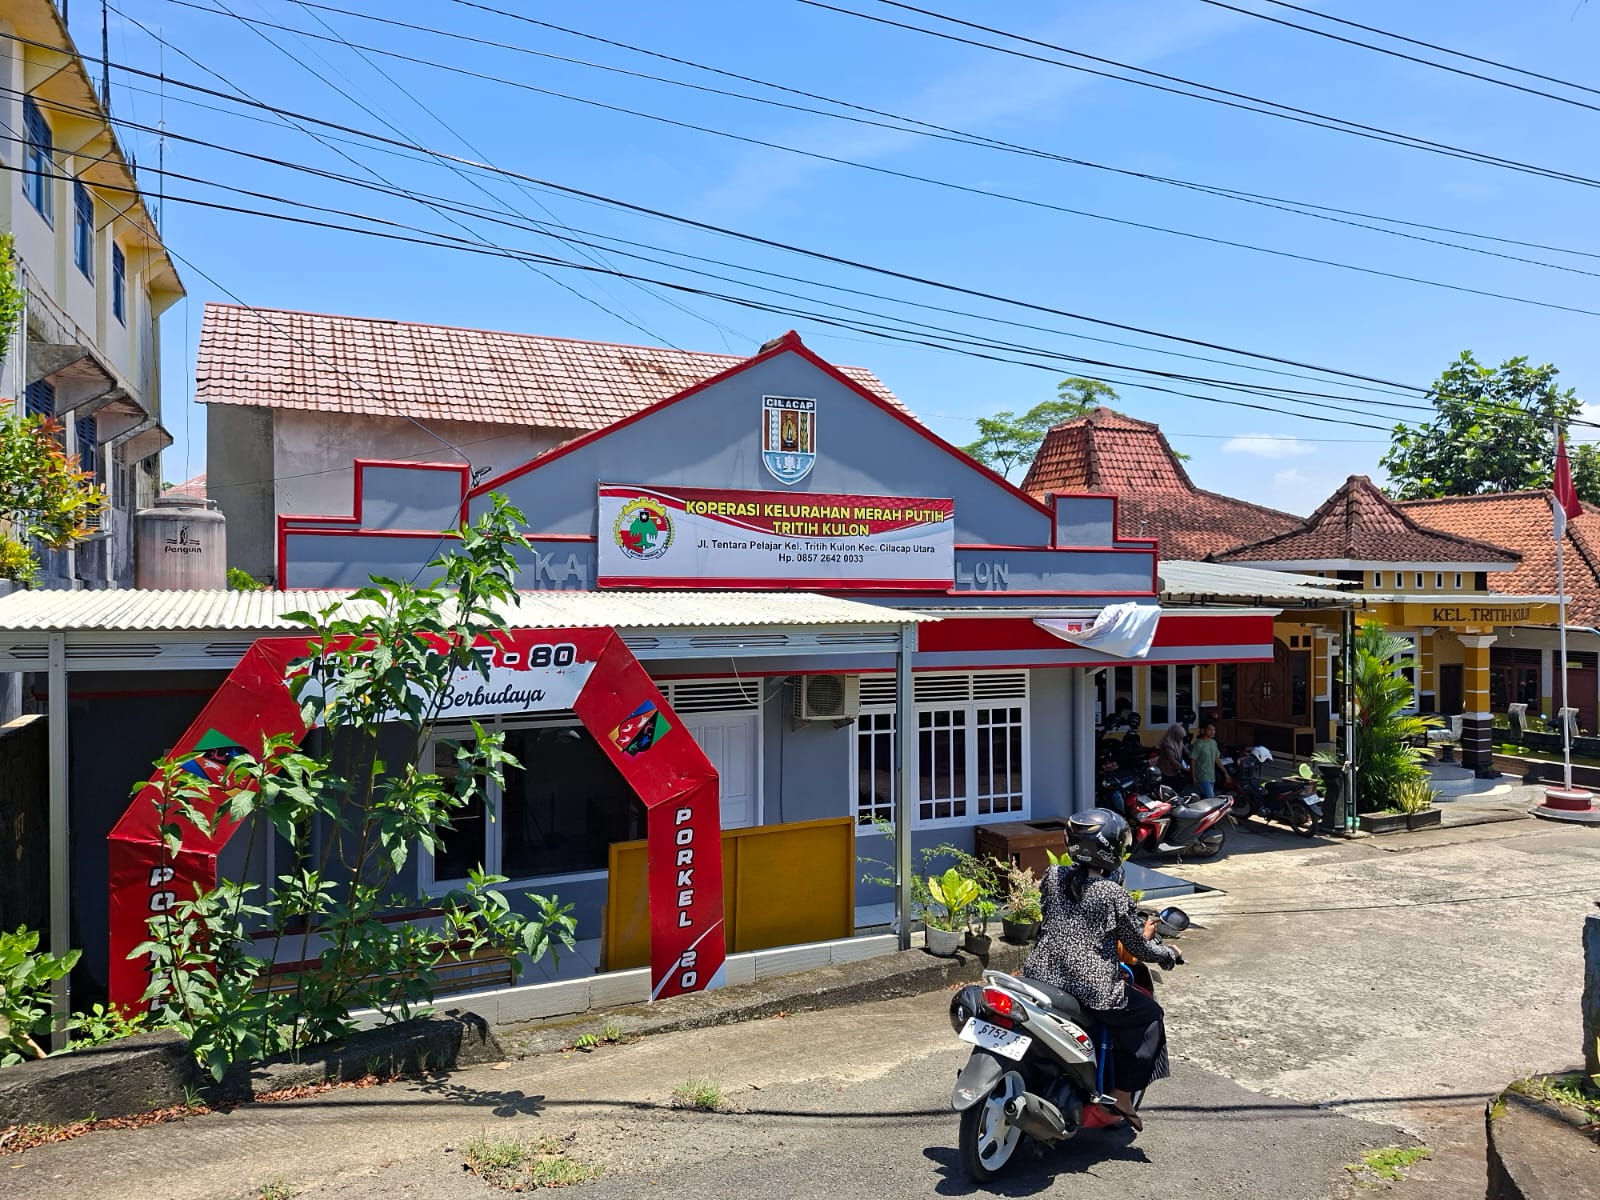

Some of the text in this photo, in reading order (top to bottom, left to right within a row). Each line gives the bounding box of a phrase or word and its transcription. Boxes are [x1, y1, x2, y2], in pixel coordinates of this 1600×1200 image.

[766, 398, 814, 410] CILACAP
[685, 500, 945, 523] KOPERASI KELURAHAN MERAH PUTIH
[773, 521, 870, 537] TRITIH KULON
[164, 545, 202, 555] Penguin
[697, 539, 935, 554] Jl. Tentara Pelajar Kel. Tritih Kulon Kec. Cilacap Utara
[778, 554, 864, 563] Hp. 0857 2642 0033
[529, 643, 576, 668] 80
[433, 684, 547, 710] Berbudaya
[673, 806, 696, 930] PORKEL
[680, 950, 698, 989] 20
[981, 1024, 1008, 1041] 6752
